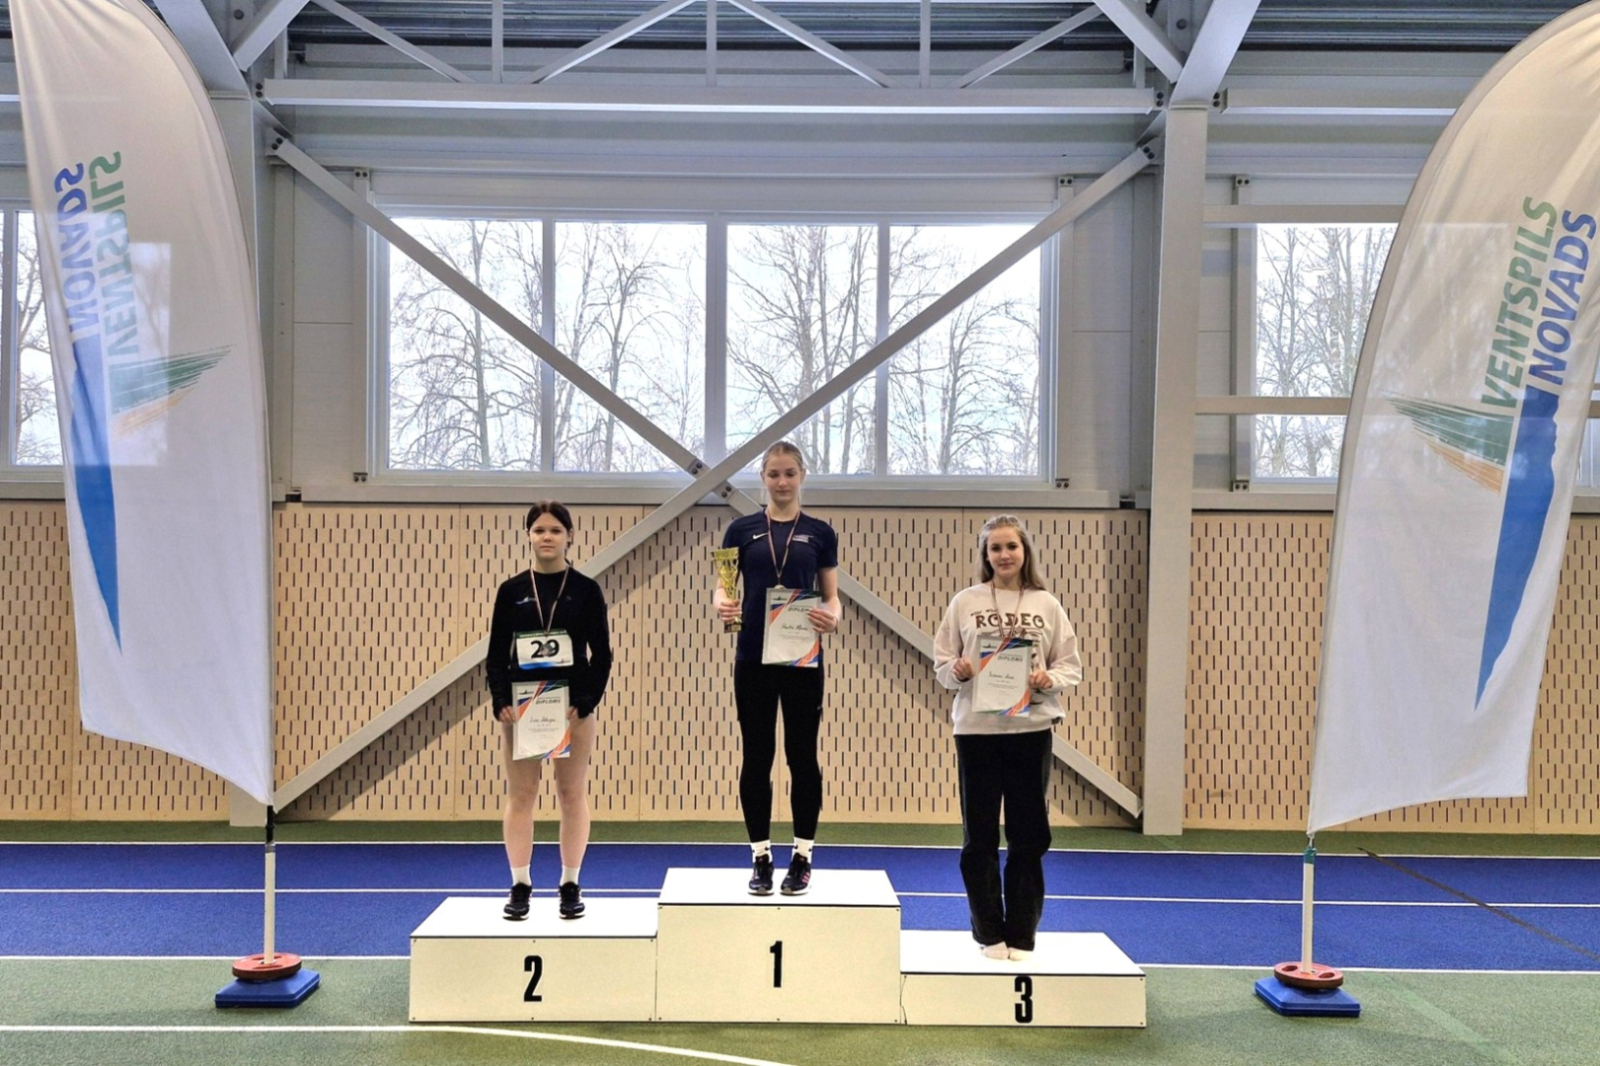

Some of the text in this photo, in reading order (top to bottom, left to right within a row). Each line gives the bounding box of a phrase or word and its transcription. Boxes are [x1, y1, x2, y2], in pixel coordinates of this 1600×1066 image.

[1481, 196, 1558, 409] VENTSPILS
[1528, 210, 1597, 386] NOVADS
[975, 612, 1045, 629] RODEO
[530, 639, 560, 659] 29
[523, 954, 543, 1002] 2
[769, 940, 783, 988] 1
[1014, 975, 1033, 1024] 3
